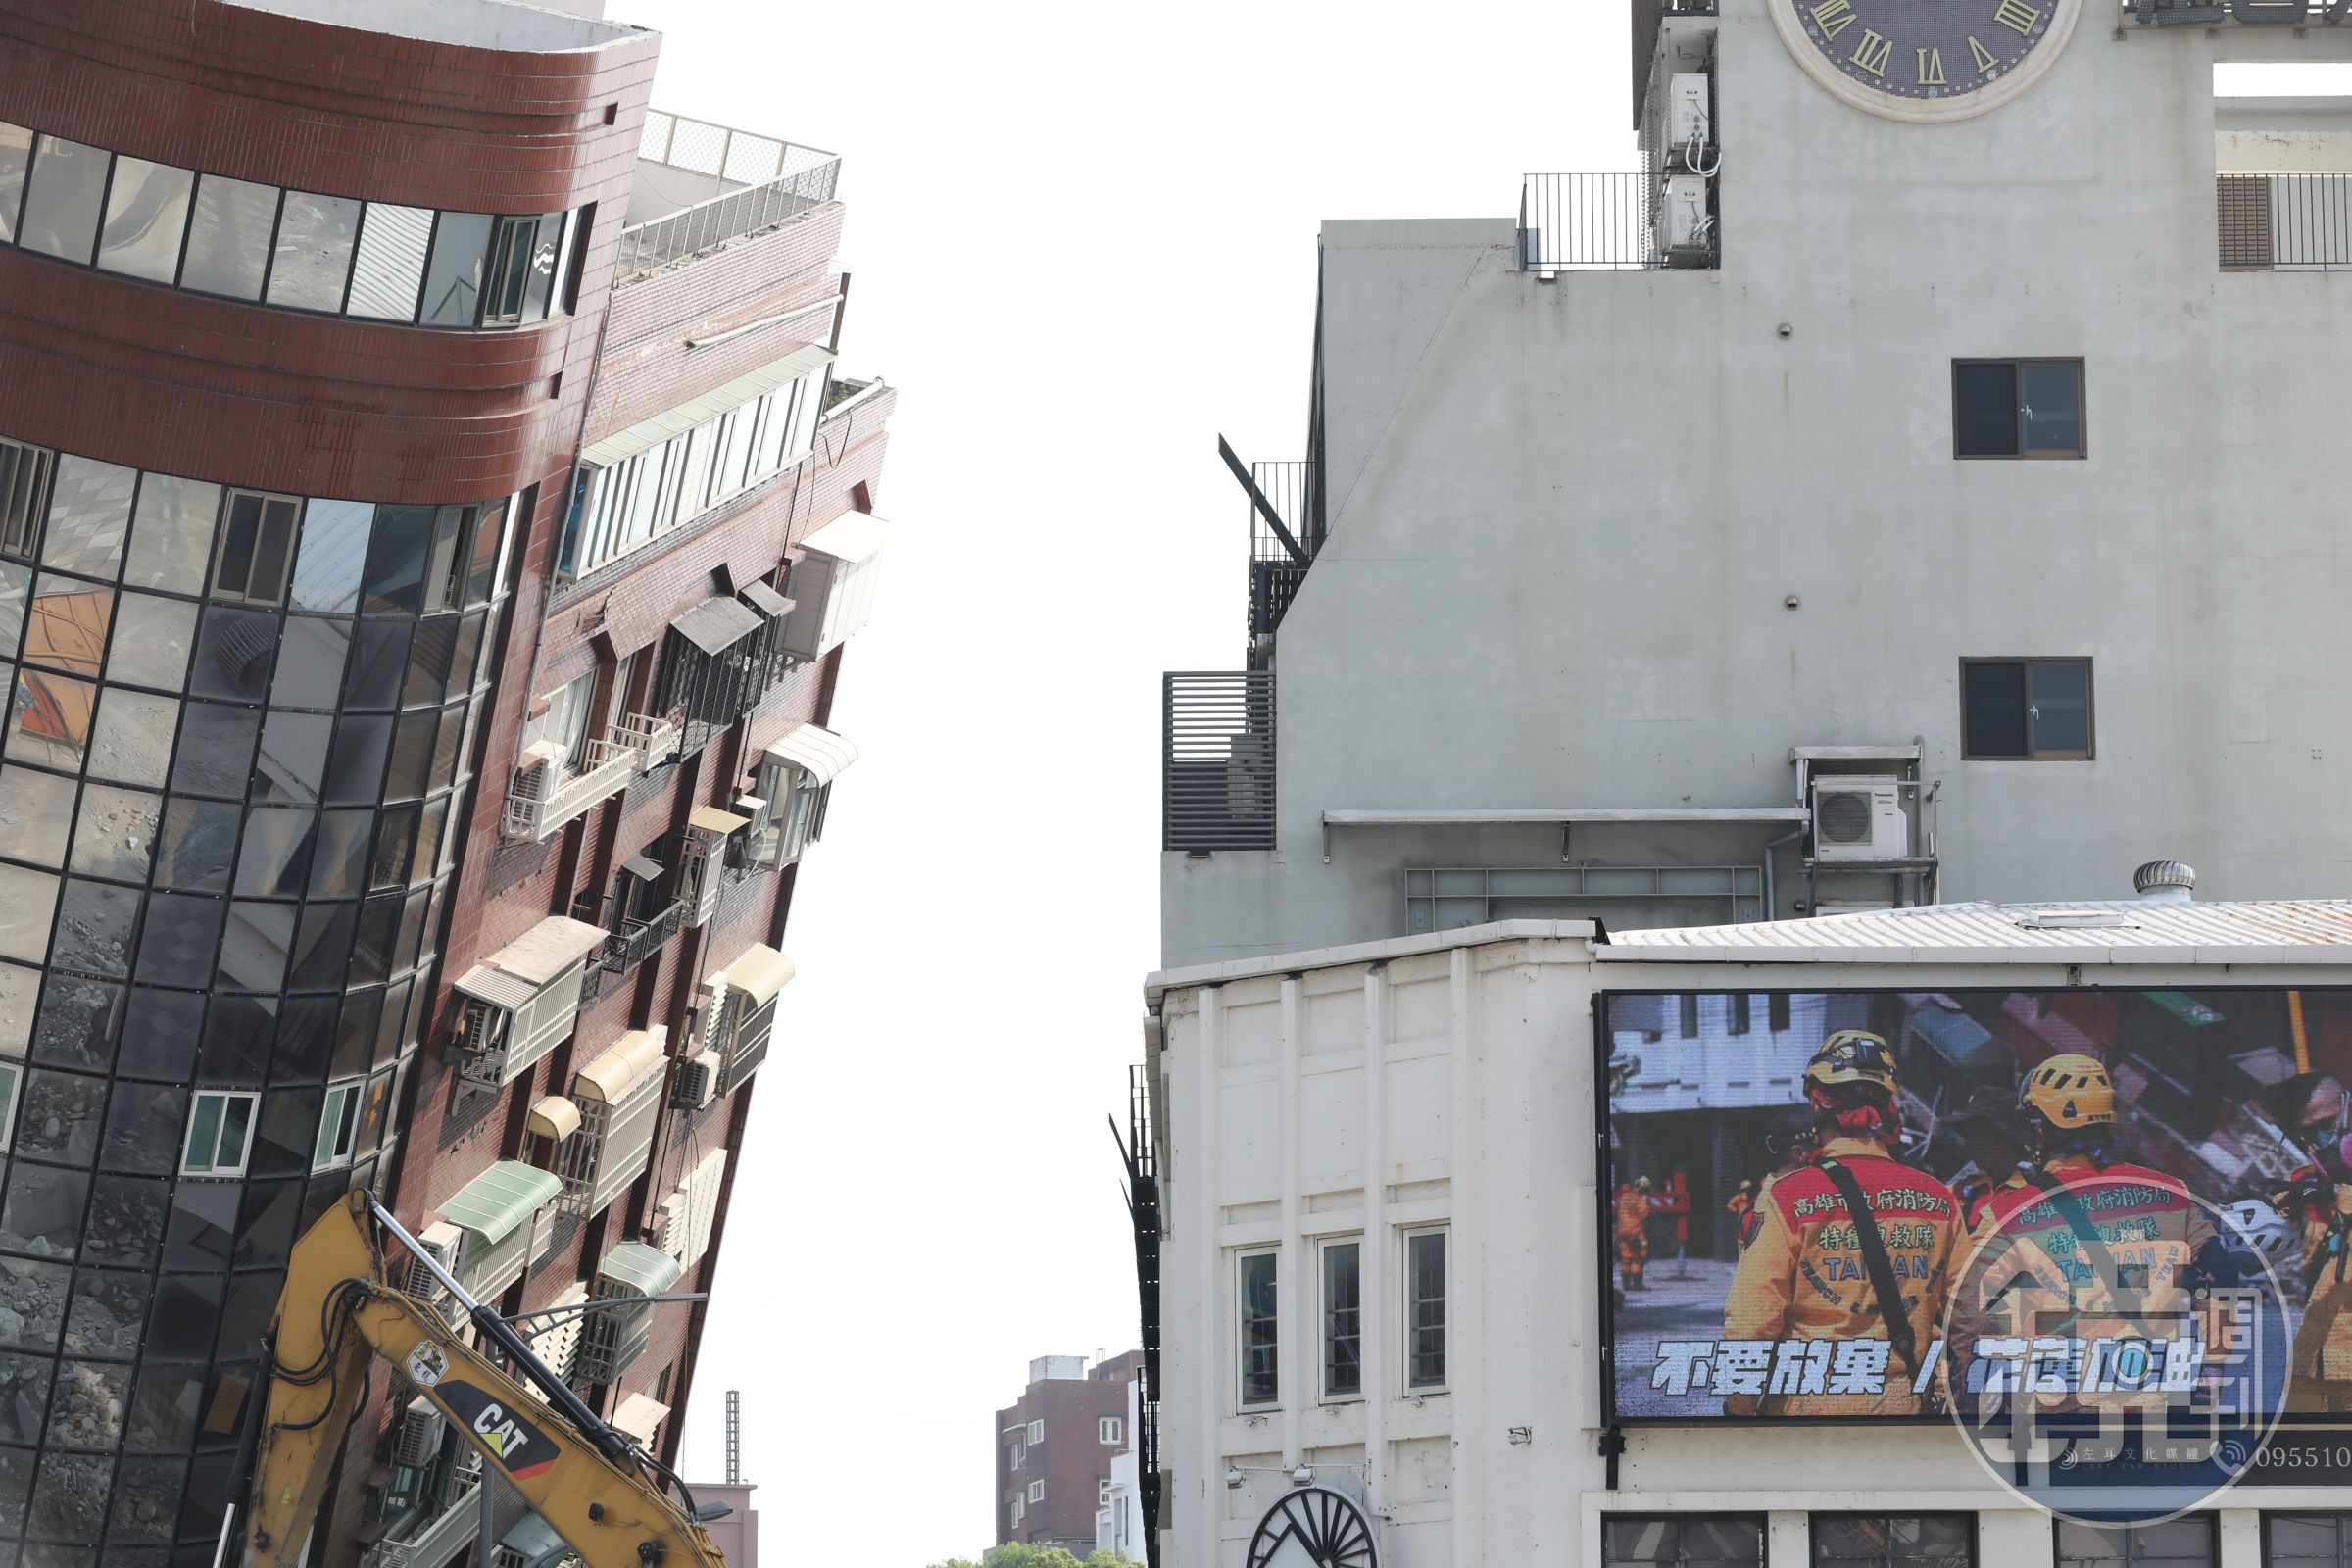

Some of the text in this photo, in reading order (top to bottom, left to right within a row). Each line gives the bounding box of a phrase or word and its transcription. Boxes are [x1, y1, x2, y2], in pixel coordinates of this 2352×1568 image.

[1849, 28, 1893, 77] VII
[1916, 48, 1948, 85] VI
[1967, 35, 1999, 74] V
[2019, 1186, 2171, 1226] 高雄政府消防局
[1823, 1255, 1929, 1281] TAIAN
[2054, 1247, 2158, 1282] TAAN
[1650, 1338, 1892, 1396] 不要放棄
[1966, 1337, 2206, 1395] 花蓮加油
[473, 1403, 529, 1460] CAT
[2082, 1447, 2199, 1461] 左耳文化媒體
[2255, 1446, 2352, 1468] 095510
